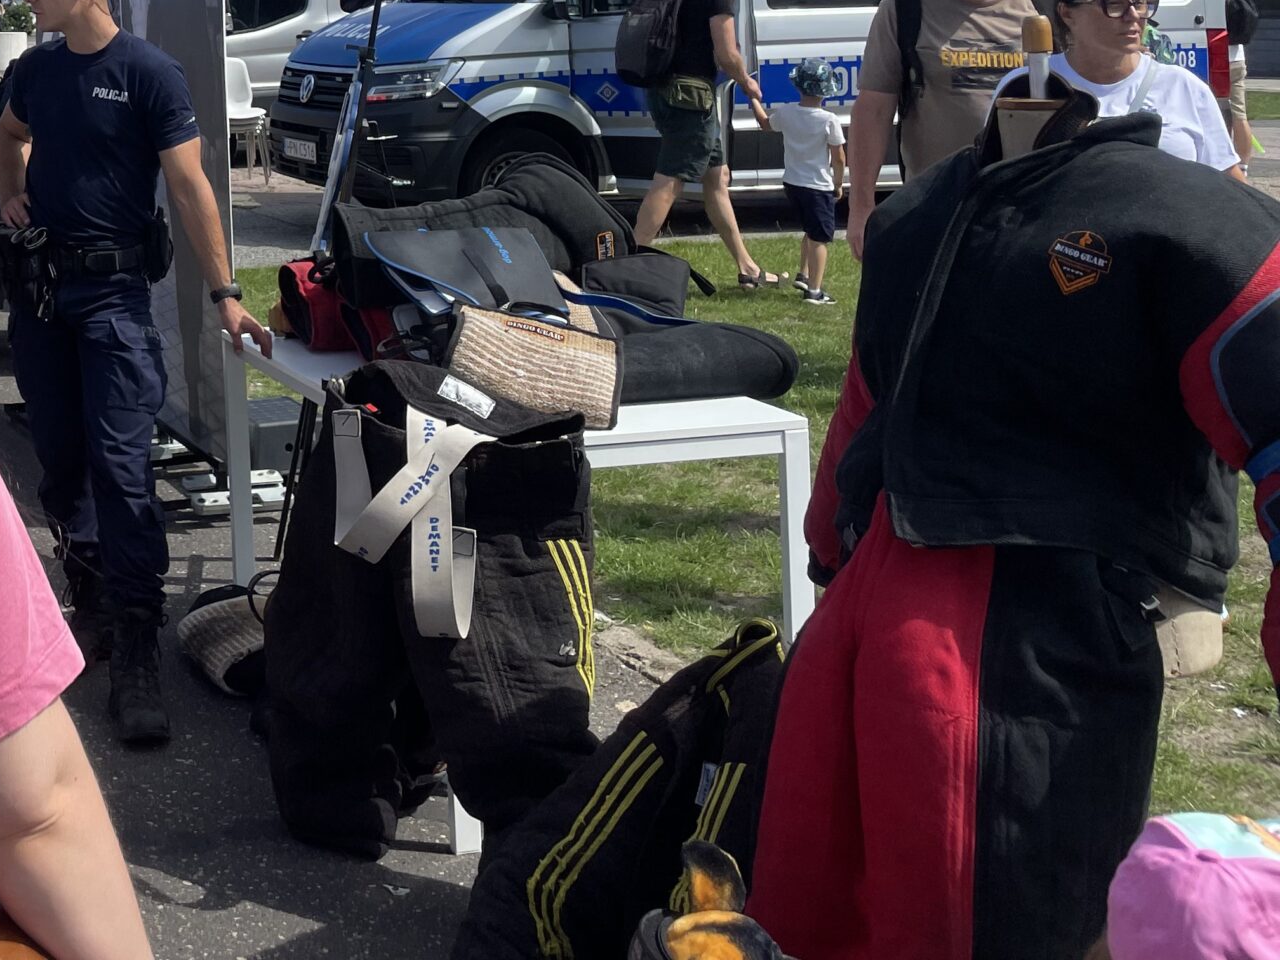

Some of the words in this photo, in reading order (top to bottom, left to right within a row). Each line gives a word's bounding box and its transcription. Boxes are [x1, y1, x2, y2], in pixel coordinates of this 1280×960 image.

[940, 50, 1024, 68] EXPEDITION
[92, 86, 129, 103] POLICJA
[1054, 243, 1080, 258] DINGO
[507, 321, 536, 332] DINGO
[428, 517, 441, 572] DEMANET
